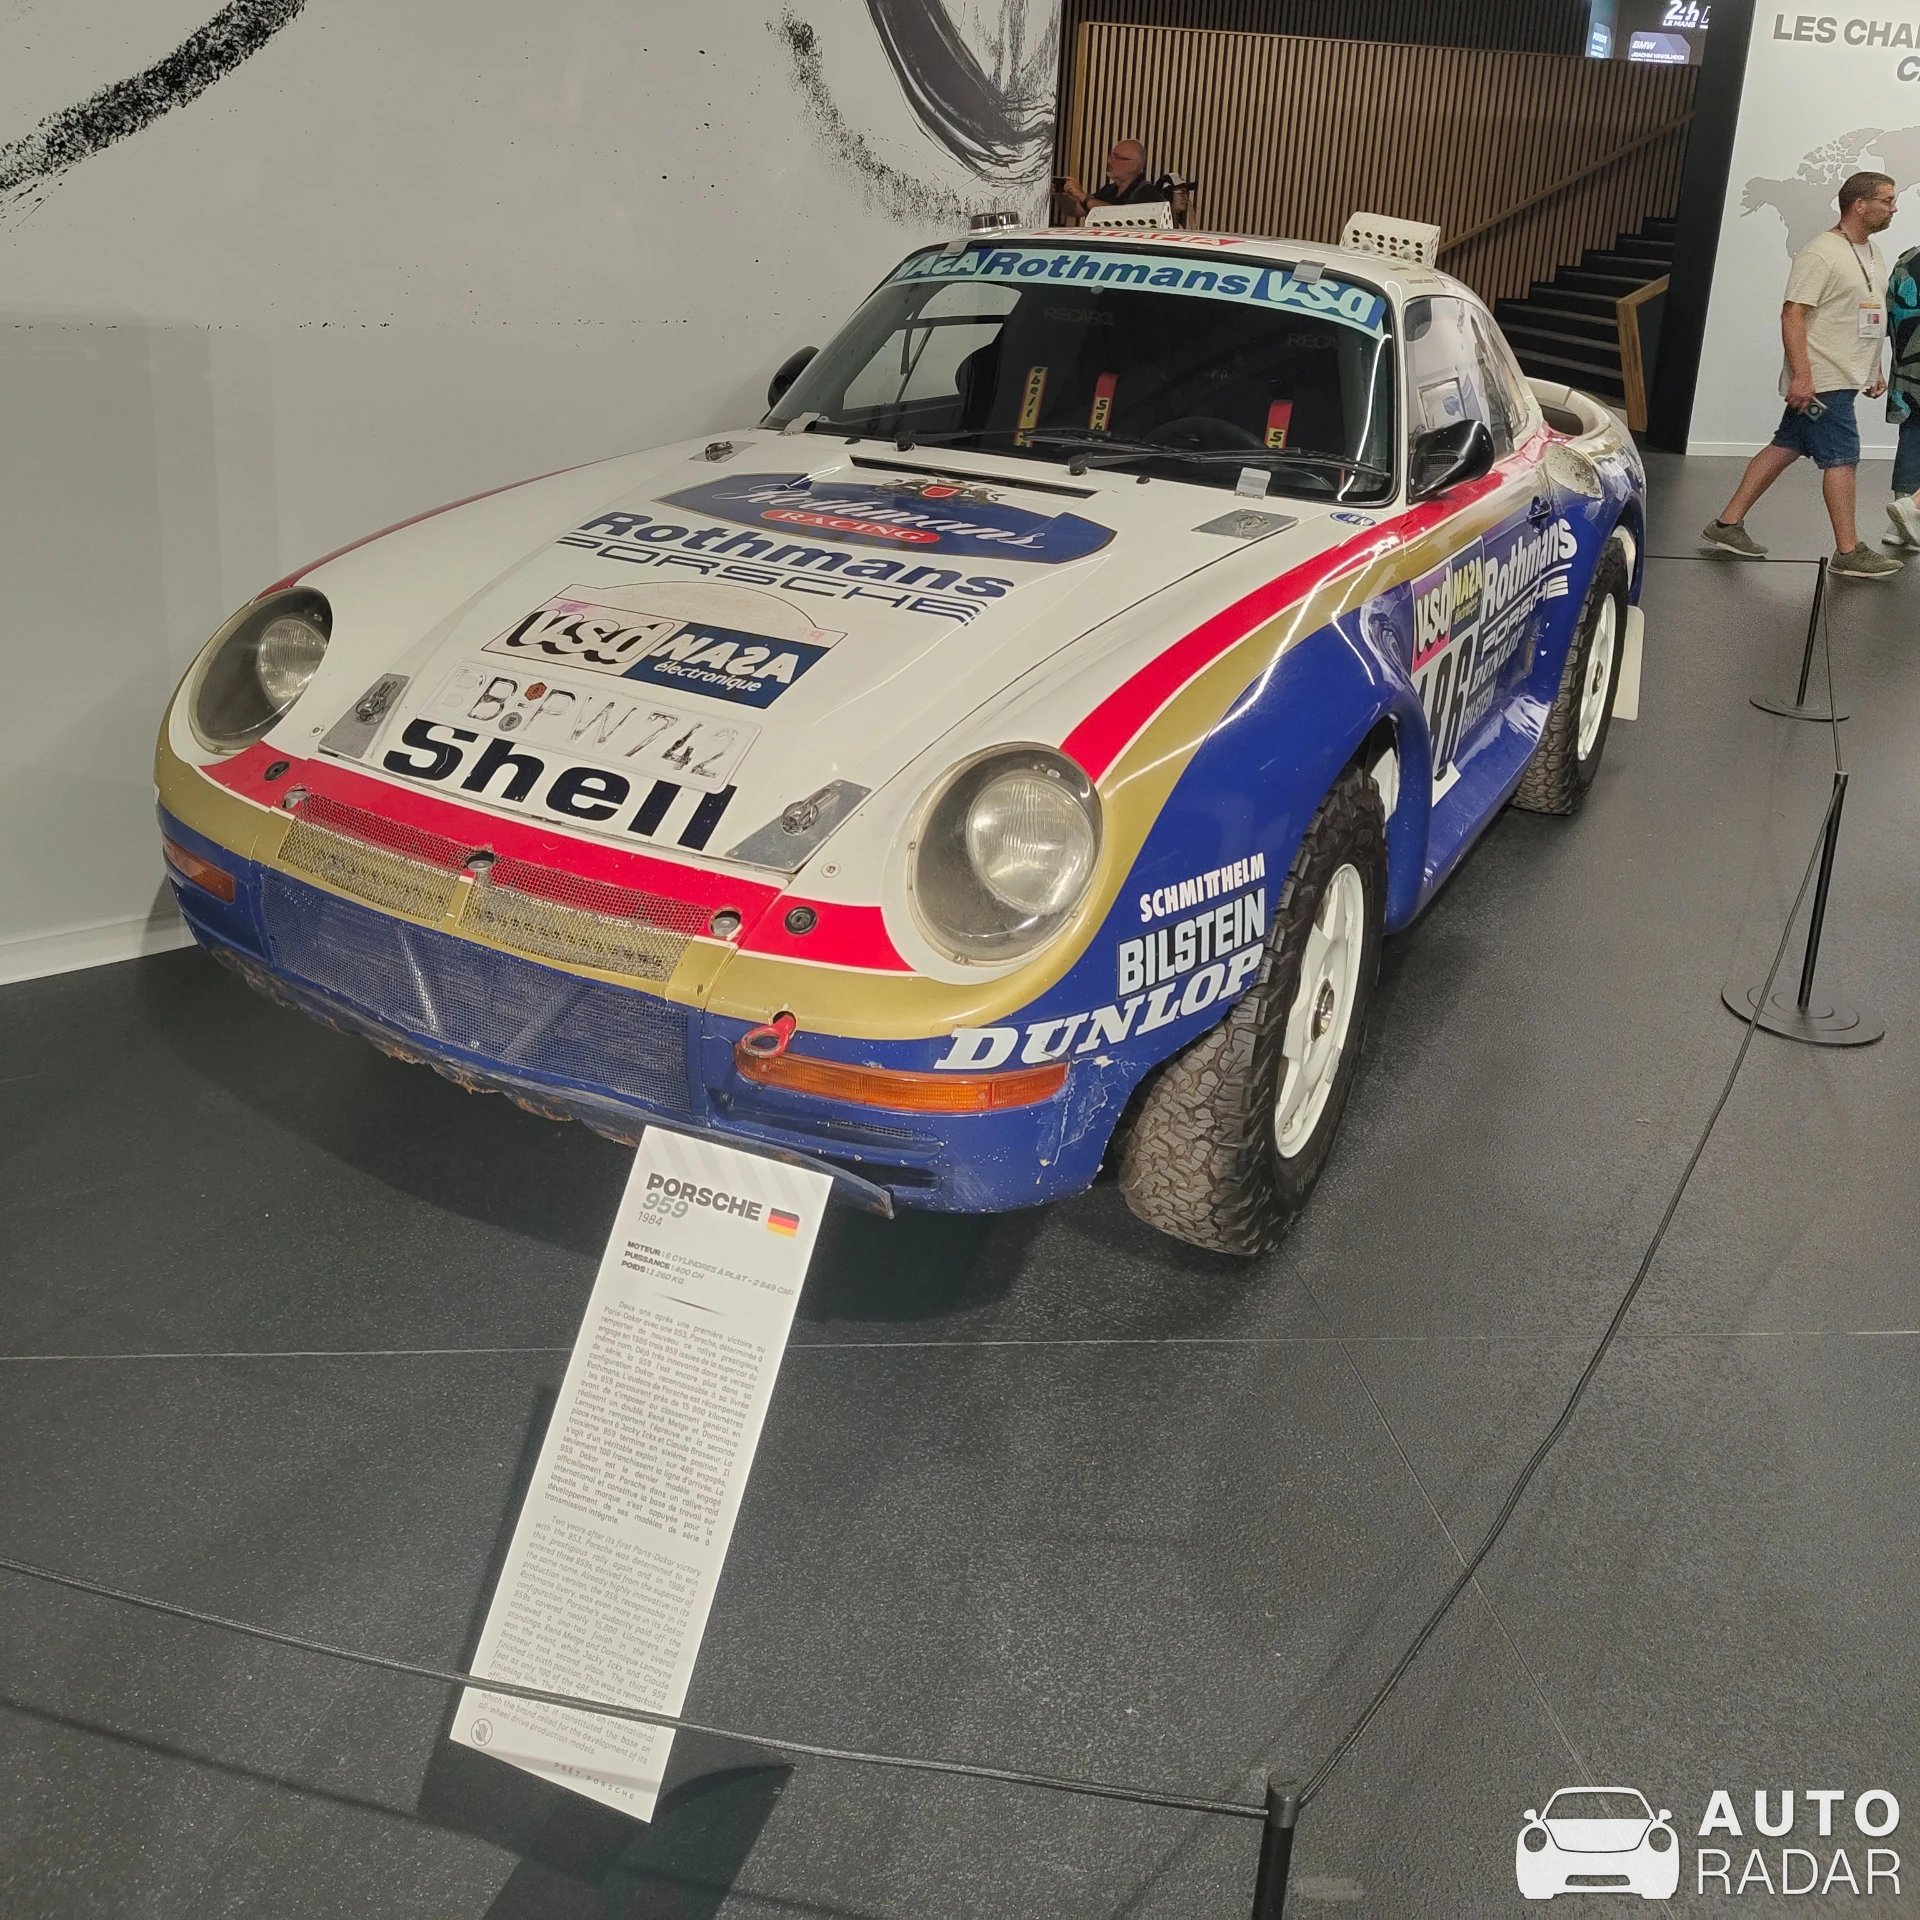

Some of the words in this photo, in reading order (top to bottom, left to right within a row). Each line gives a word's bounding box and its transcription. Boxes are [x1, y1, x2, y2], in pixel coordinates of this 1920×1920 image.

[1665, 0, 1700, 21] 24h
[1773, 14, 1837, 43] LES
[1844, 19, 1920, 49] CHA
[1632, 41, 1656, 50] BMW
[1897, 56, 1920, 82] C
[980, 251, 1250, 295] Rothmans
[1287, 333, 1337, 349] RECA
[1025, 367, 1045, 418] abelt
[712, 483, 1046, 549] Rothmans
[780, 511, 926, 541] RACING
[577, 511, 1015, 598] Rothmans
[1480, 518, 1578, 625] Rothmans
[556, 534, 989, 627] PORSCHE
[1481, 575, 1568, 660] PORSCHE
[653, 660, 763, 692] électronique
[1469, 623, 1526, 696] DUNLOP
[382, 718, 738, 850] Shell
[1140, 852, 1265, 922] SCHMITTHELM
[1118, 888, 1265, 996] BILSTEIN
[934, 943, 1265, 1069] DUNLOP
[638, 1211, 663, 1227] 1984
[642, 1192, 689, 1219] 959
[645, 1172, 763, 1222] PORSCHE
[620, 1259, 646, 1273] POIDS
[654, 1270, 672, 1281] 260
[671, 1275, 685, 1285] KG
[624, 1250, 671, 1270] PUISSANCE
[674, 1266, 692, 1276] 400
[691, 1271, 705, 1280] CH
[627, 1240, 661, 1257] MOTEUR
[671, 1254, 718, 1274] CYLINDRES
[723, 1270, 747, 1282] PLAT
[600, 1316, 634, 1331] remporter
[650, 1332, 680, 1346] nouveau
[696, 1347, 717, 1358] rallye
[618, 1300, 636, 1312] Deux
[638, 1308, 651, 1317] ans
[654, 1313, 674, 1324] après
[677, 1321, 690, 1330] une
[692, 1325, 724, 1340] première
[727, 1336, 753, 1349] victoire
[589, 1352, 632, 1371] configuration
[658, 1375, 709, 1397] reconnaissable
[729, 1397, 750, 1410] livrée
[577, 1388, 607, 1404] réalisant
[647, 1411, 665, 1423] René
[667, 1417, 689, 1432] Metge
[701, 1426, 739, 1448] Dominique
[580, 1379, 600, 1391] avant
[613, 1387, 646, 1406] s'imposer
[660, 1406, 700, 1425] classement
[702, 1420, 729, 1435] général
[608, 1409, 646, 1428] remportent
[649, 1422, 683, 1439] l'épreuve
[707, 1443, 736, 1458] seconde
[556, 1454, 602, 1476] officiellement
[603, 1471, 617, 1480] par
[618, 1474, 647, 1491] Porsche
[649, 1486, 667, 1498] dans
[681, 1498, 720, 1517] rallye-raid
[559, 1443, 574, 1455] 959
[578, 1450, 599, 1463] Dakar
[604, 1461, 616, 1470] est
[634, 1470, 659, 1484] dernier
[664, 1478, 690, 1496] modèle
[696, 1493, 722, 1508] engagé
[547, 1482, 598, 1506] développement
[616, 1508, 629, 1517] ses
[633, 1514, 668, 1530] modèles
[682, 1527, 700, 1543] série
[552, 1515, 566, 1527] Two
[566, 1522, 586, 1534] years
[586, 1529, 605, 1540] after
[605, 1536, 615, 1545] its
[615, 1539, 632, 1551] first
[632, 1545, 676, 1566] Paris-Dakar
[676, 1562, 702, 1578] victory
[543, 1623, 562, 1637] René
[562, 1630, 585, 1646] Metge
[585, 1638, 601, 1651] and
[600, 1645, 639, 1667] Dominique
[565, 1596, 600, 1617] Porsche's
[601, 1613, 634, 1631] audacity
[634, 1626, 653, 1637] paid
[669, 1638, 682, 1648] the
[500, 1629, 532, 1647] Brasseur
[535, 1643, 552, 1655] took
[555, 1652, 582, 1667] second
[611, 1672, 625, 1684] The
[628, 1680, 648, 1693] third
[651, 1688, 667, 1700] 959
[477, 1702, 511, 1720] all-wheel
[510, 1714, 530, 1728] drive
[529, 1723, 568, 1743] production
[553, 1762, 582, 1778] PRÊT
[586, 1773, 634, 1800] PORSCHE
